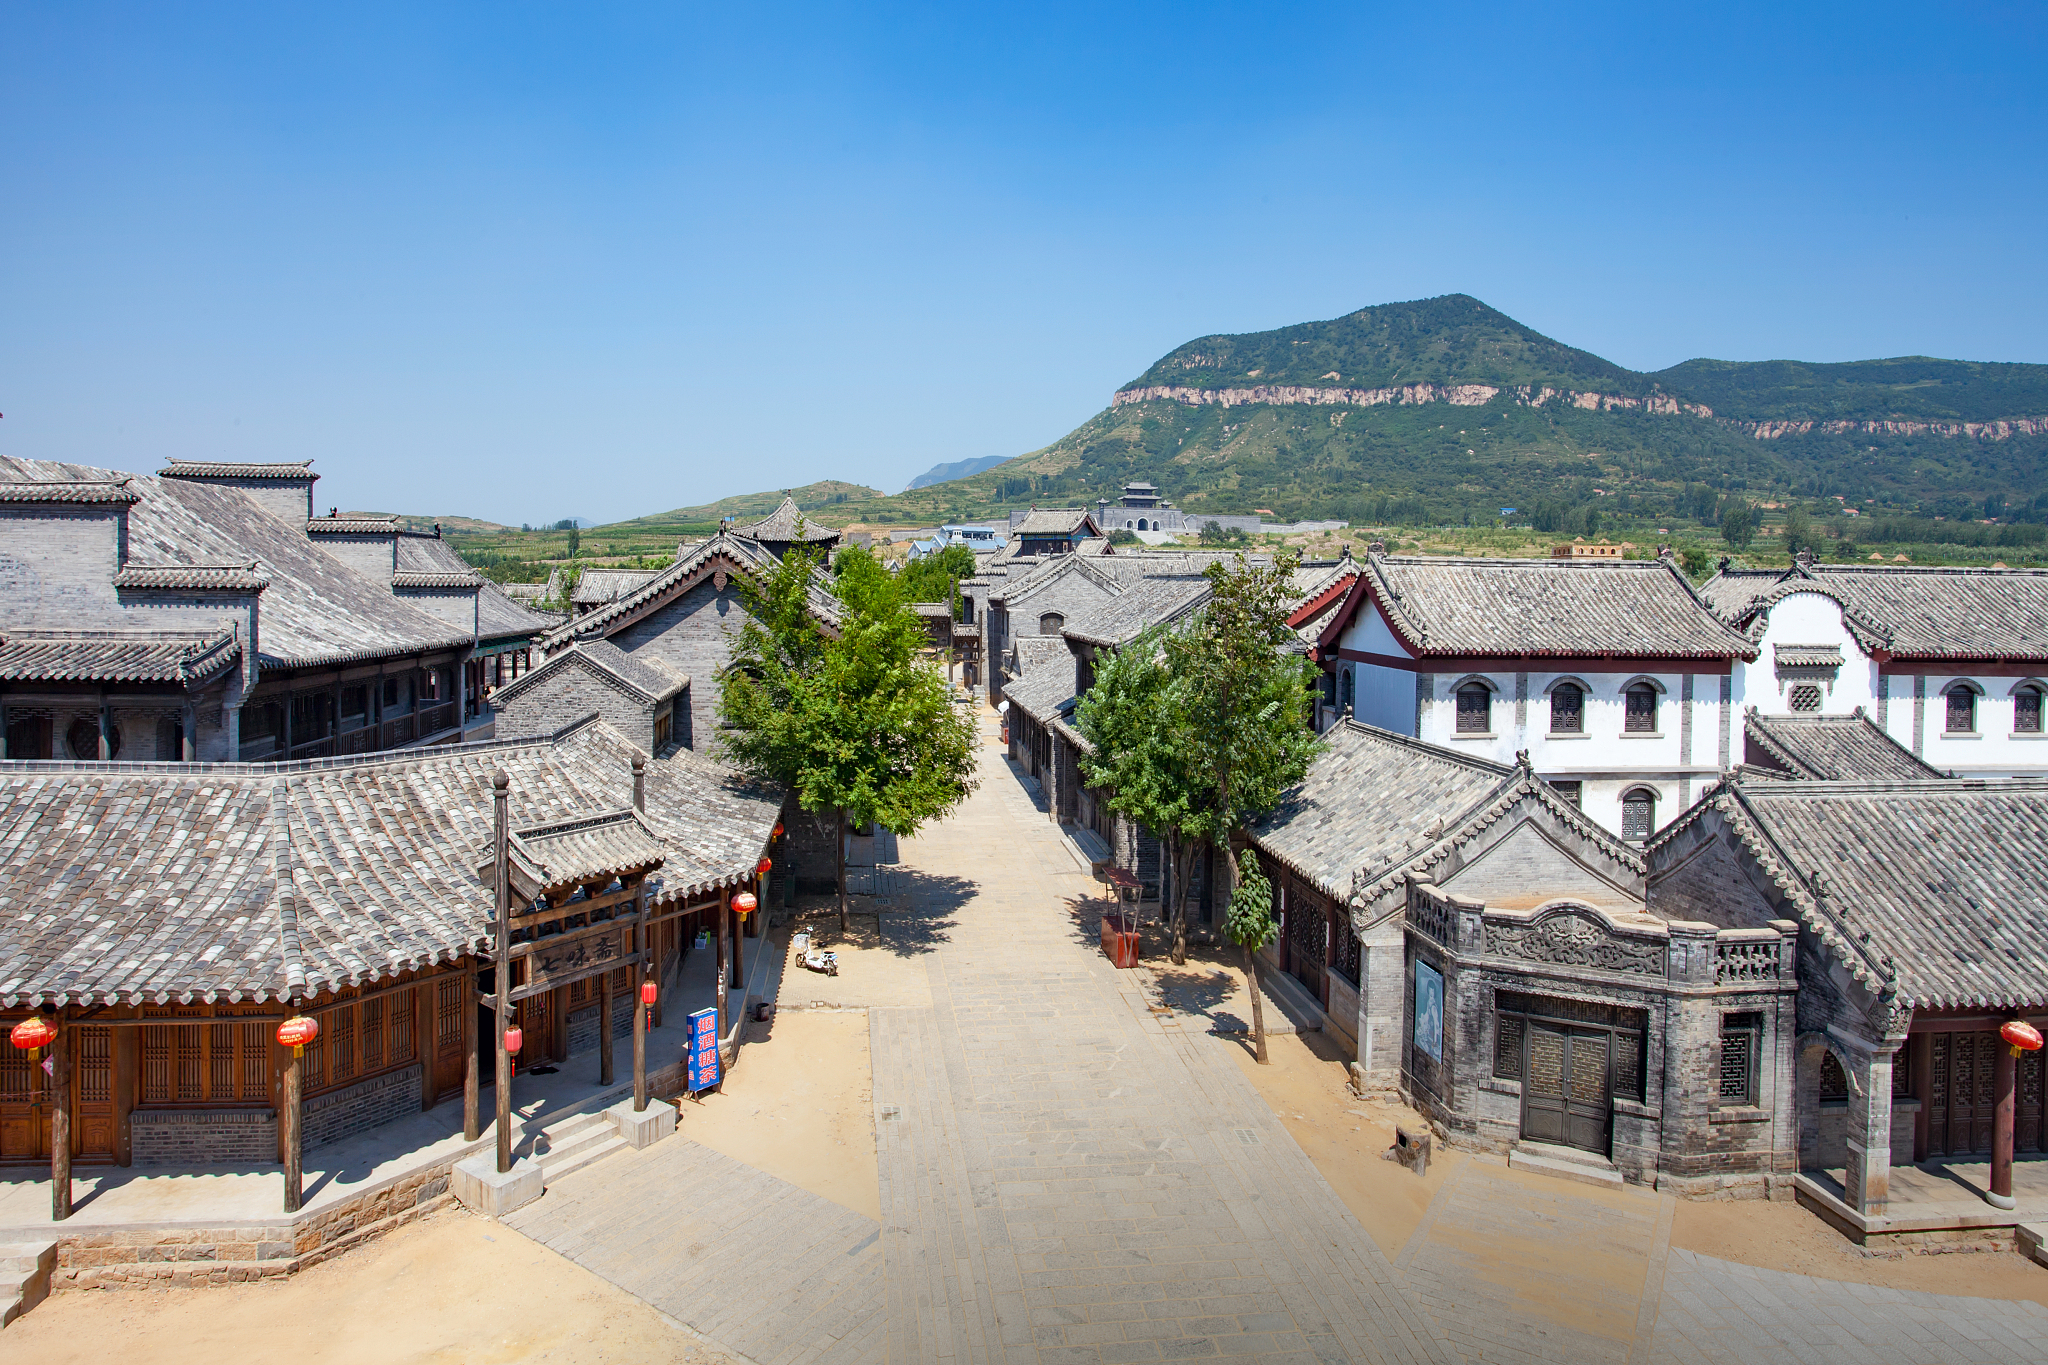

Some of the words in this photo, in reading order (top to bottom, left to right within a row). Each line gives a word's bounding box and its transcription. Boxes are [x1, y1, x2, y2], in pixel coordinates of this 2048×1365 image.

[535, 937, 617, 973] 七味斋
[697, 1014, 717, 1085] 烟酒糖茶
